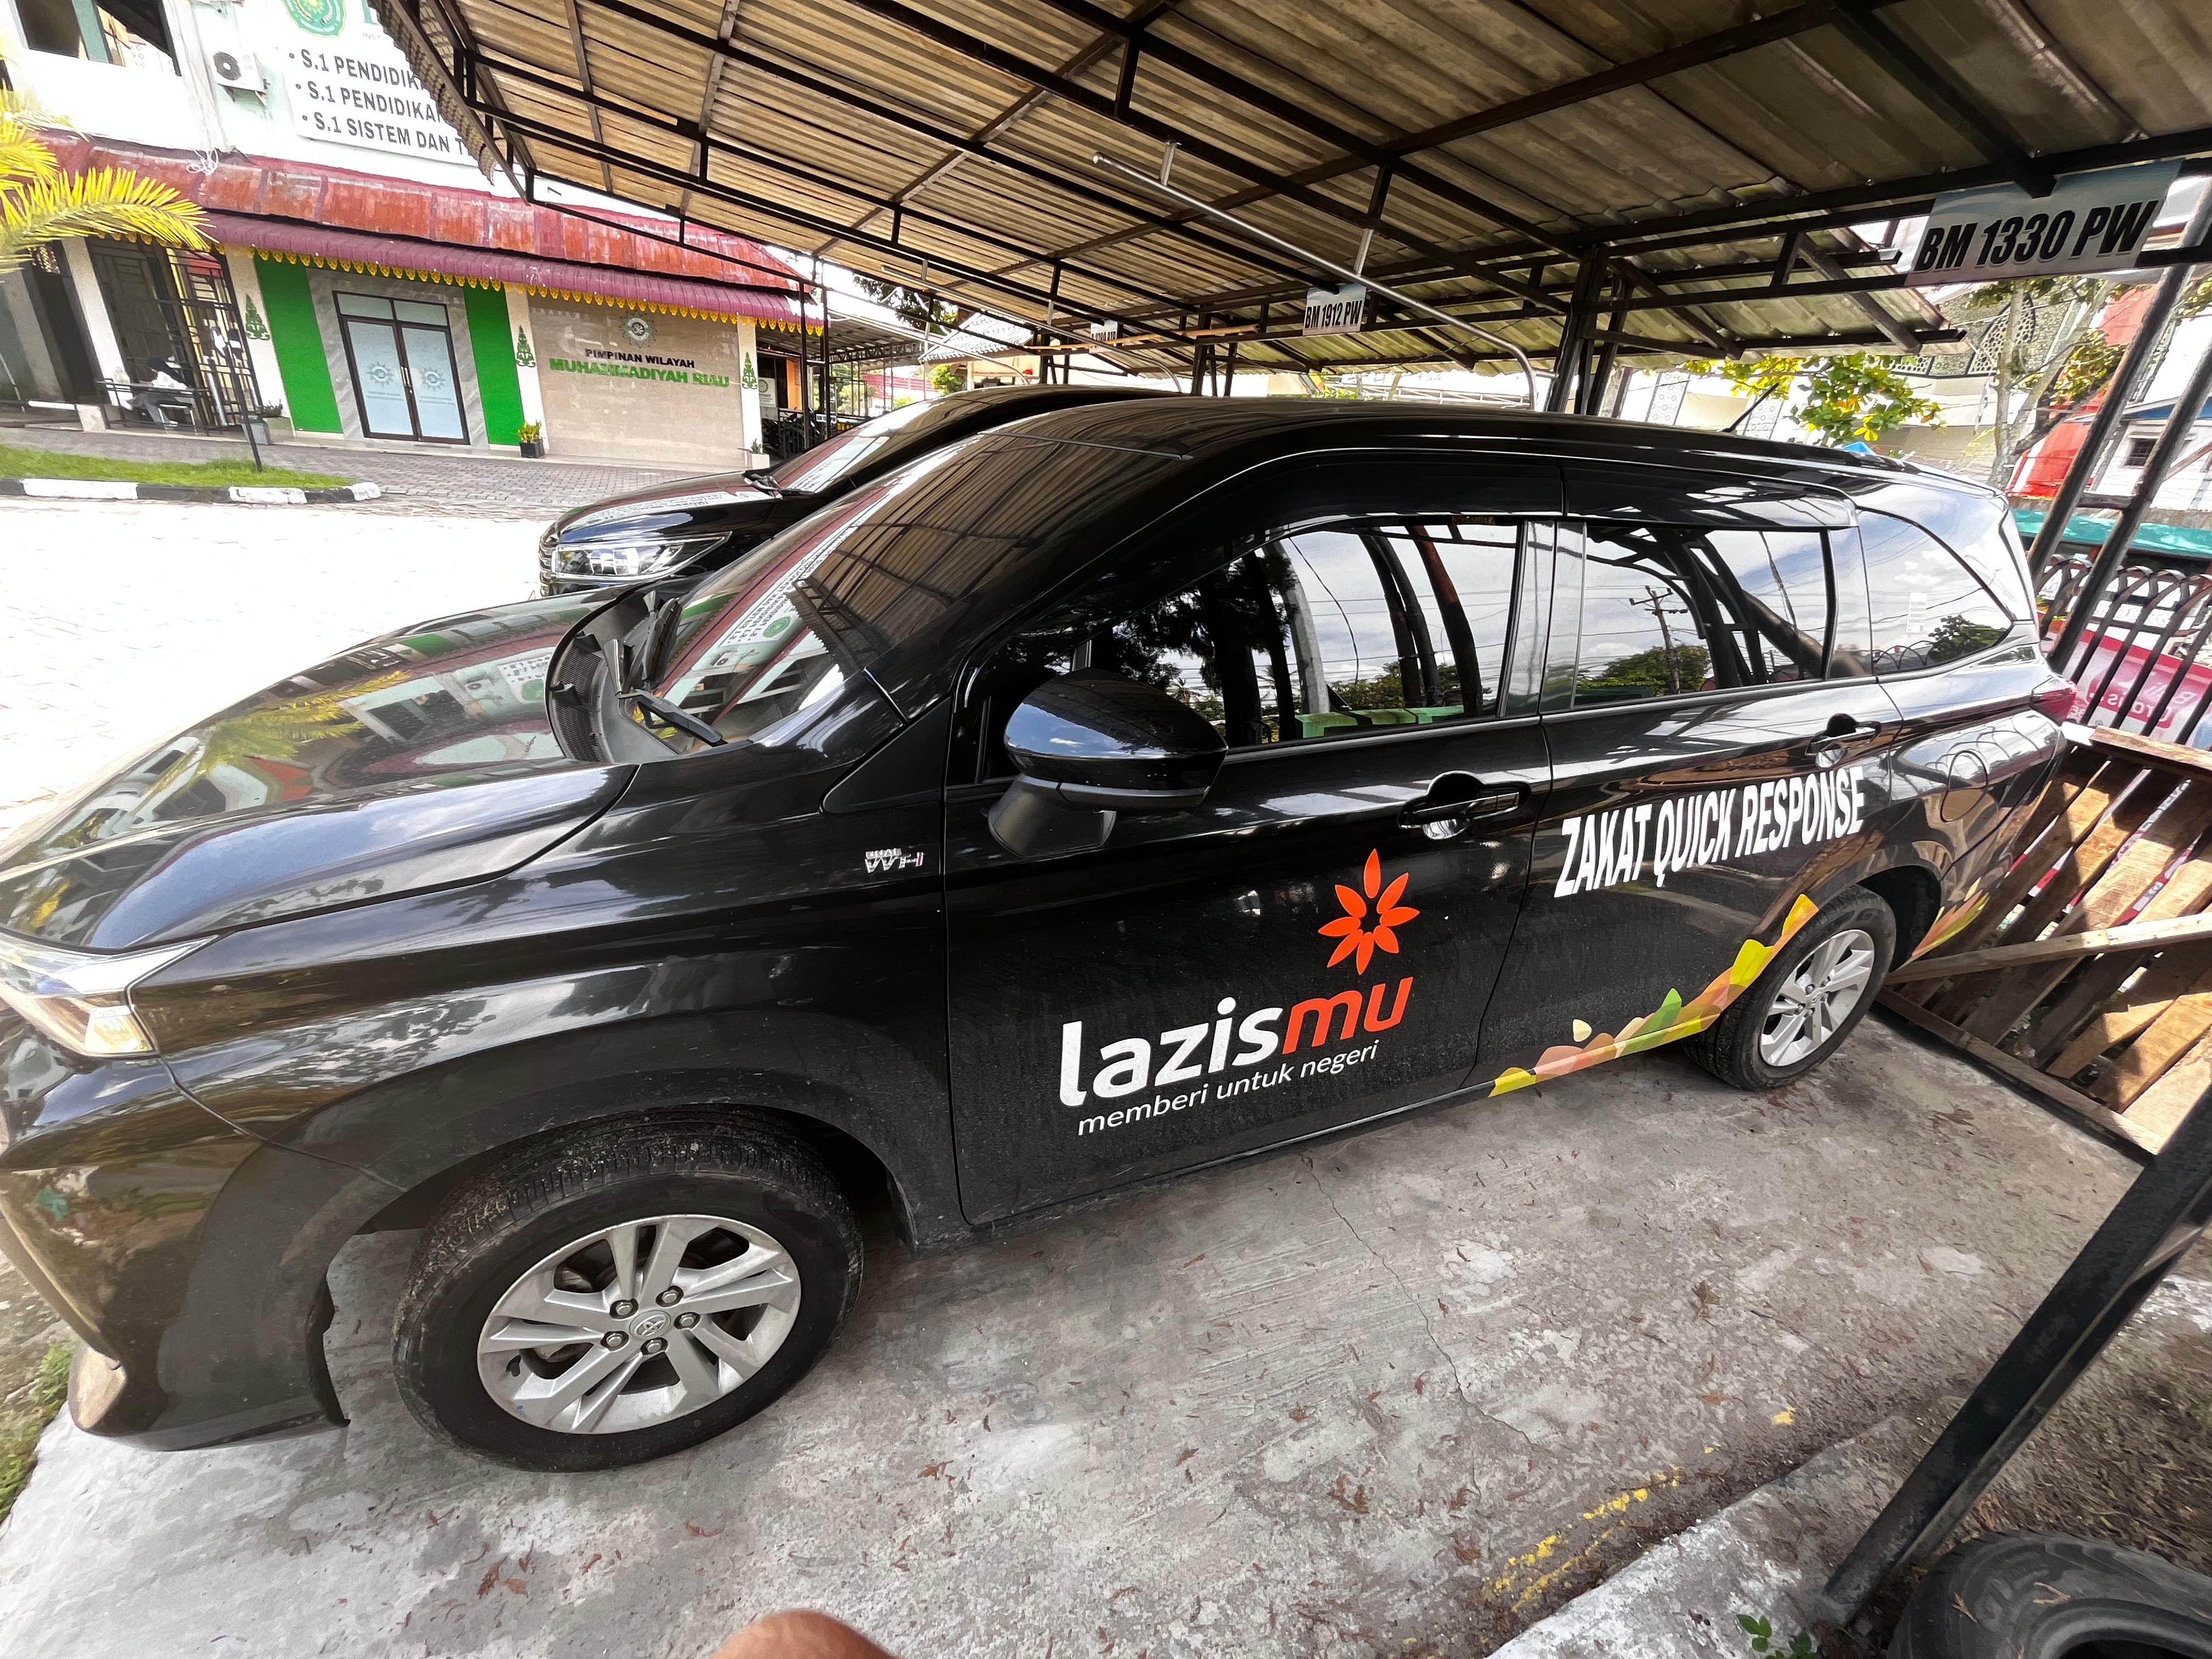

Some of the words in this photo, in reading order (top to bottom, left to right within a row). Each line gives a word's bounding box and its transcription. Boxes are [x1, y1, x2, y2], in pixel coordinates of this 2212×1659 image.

[301, 49, 329, 72] S.1
[334, 56, 423, 90] PENDIDIK
[308, 81, 335, 103] S.1
[314, 112, 341, 133] S.1
[347, 118, 411, 146] SISTEM
[416, 131, 450, 153] DAN
[1914, 222, 1978, 272] BM
[1976, 209, 2076, 267] 1330
[2070, 199, 2160, 258] PW
[1305, 305, 1321, 329] BM
[1321, 302, 1343, 328] 1912
[1342, 300, 1363, 325] PW
[549, 357, 689, 384] MUHAMMADIYAH
[692, 372, 730, 388] RIAU
[585, 348, 643, 363] PIMPINAN
[645, 355, 695, 369] WILAYAH
[1553, 803, 1652, 898] ZAKAT
[1653, 788, 1736, 888] QUICK
[1735, 765, 1865, 858] RESPONSE
[1059, 976, 1413, 1107] lazismu
[1077, 1085, 1209, 1137] memberi
[1216, 1063, 1294, 1100] untuk
[1299, 1039, 1380, 1079] negeri
